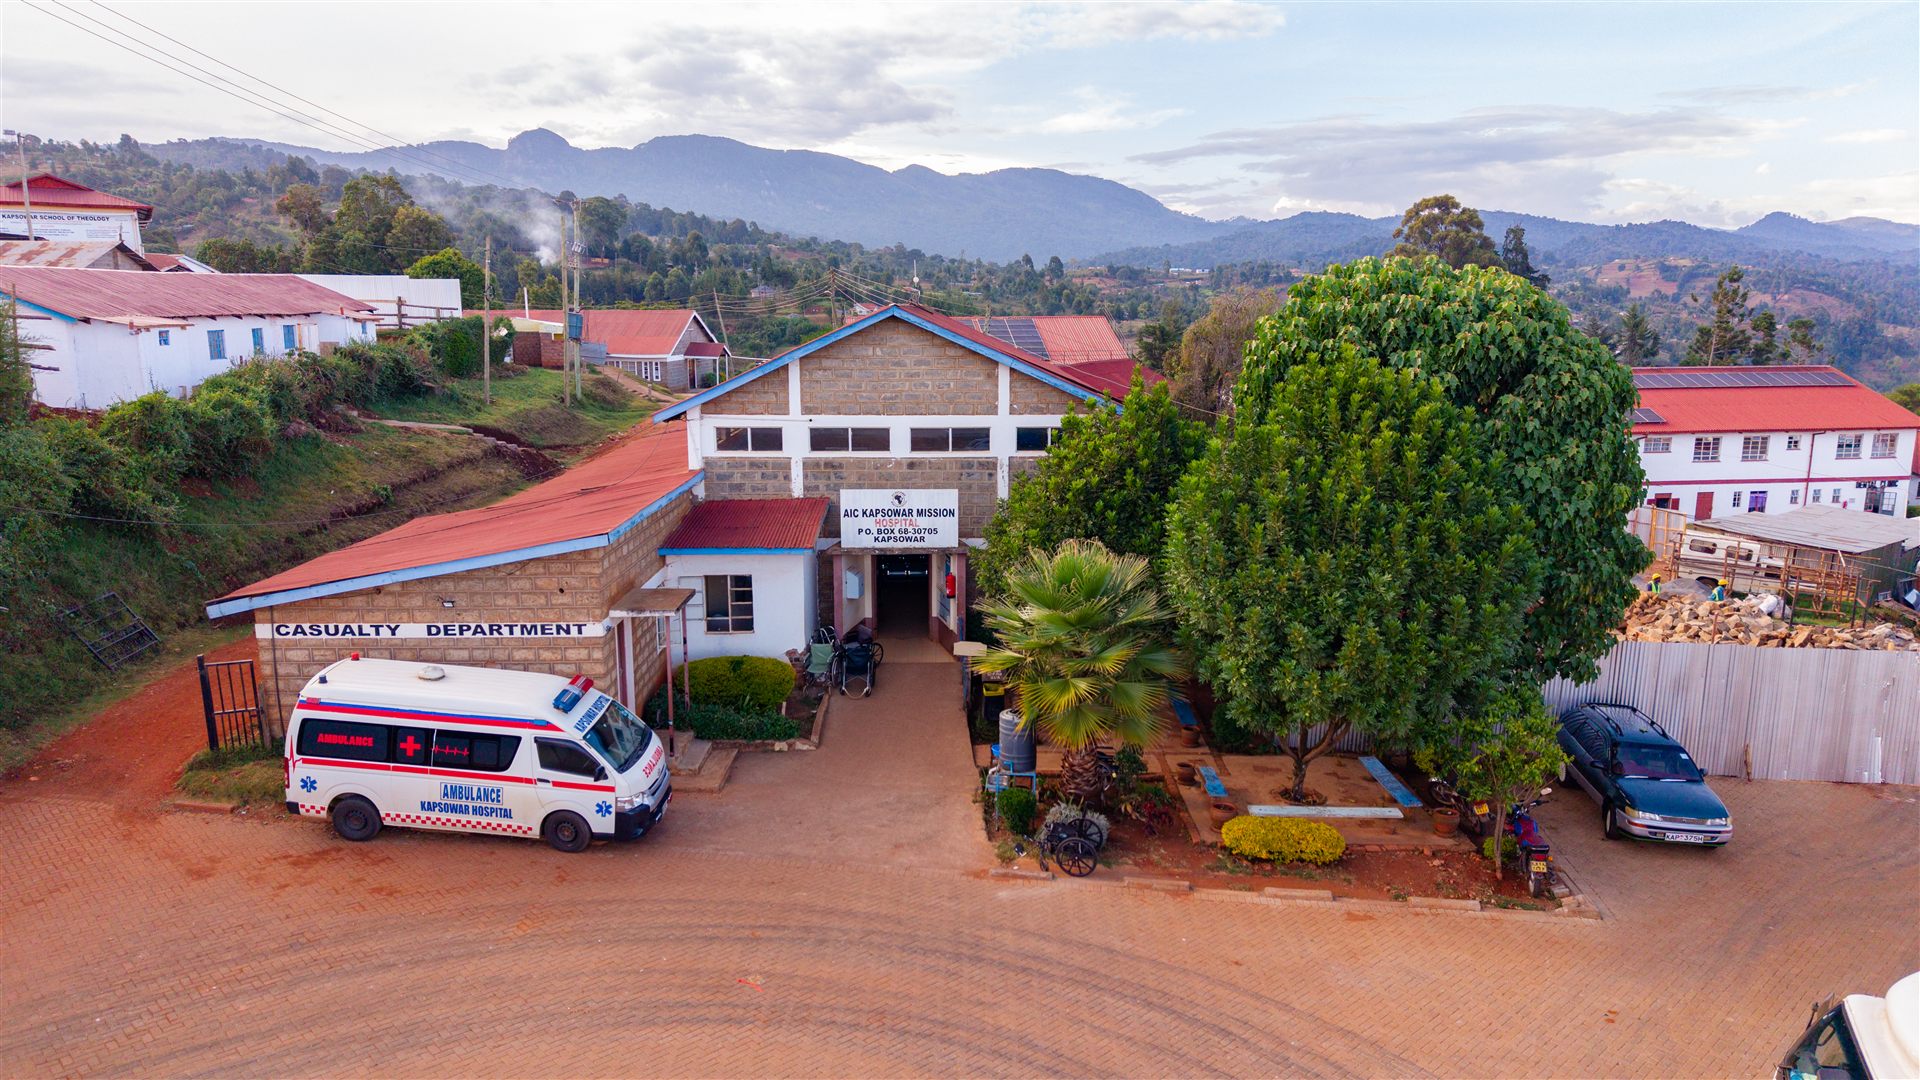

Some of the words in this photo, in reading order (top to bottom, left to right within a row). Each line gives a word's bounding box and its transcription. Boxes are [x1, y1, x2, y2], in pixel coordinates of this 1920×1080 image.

[843, 508, 859, 518] AIC
[861, 508, 914, 518] KAPSOWAR
[916, 508, 955, 518] MISSION
[875, 518, 920, 528] HOSPITAL
[275, 624, 401, 637] CASUALTY
[426, 623, 587, 637] DEPARTMENT
[574, 708, 599, 733] KAPSOWAR
[317, 733, 374, 747] AMBULANCE
[442, 784, 501, 804] AMBULANCE
[420, 800, 470, 815] KAPSOWAR
[471, 805, 513, 819] HOSPITAL
